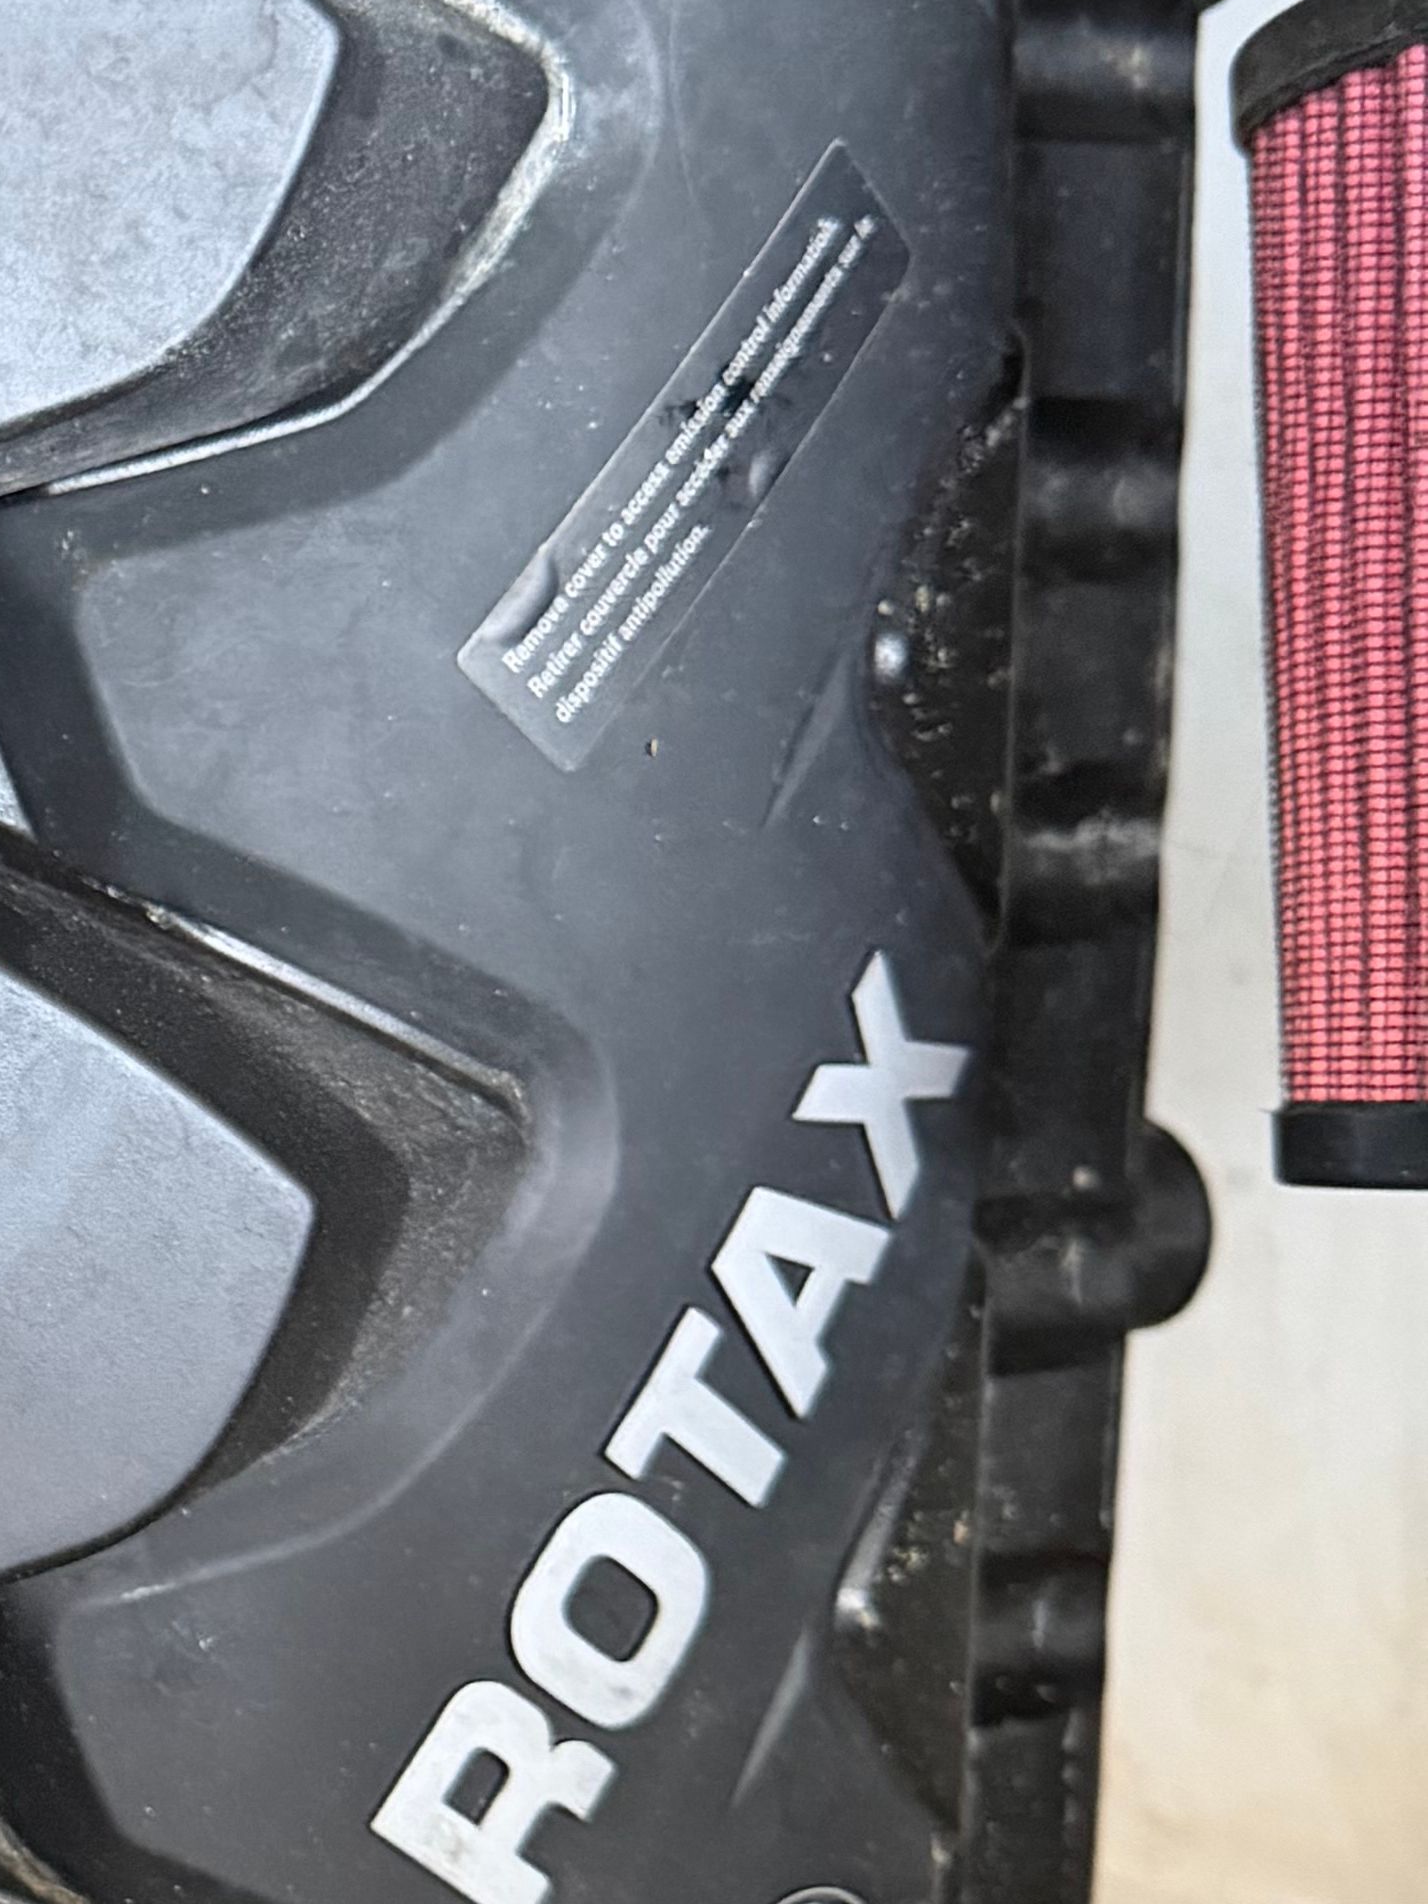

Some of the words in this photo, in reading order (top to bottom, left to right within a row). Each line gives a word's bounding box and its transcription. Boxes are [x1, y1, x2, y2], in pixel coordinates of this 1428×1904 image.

[502, 594, 569, 673] Remove
[563, 546, 606, 599] cover
[600, 522, 625, 547] to
[619, 461, 671, 526] access
[664, 382, 725, 464] emission
[719, 317, 770, 386] control
[527, 634, 584, 698] Retirer
[577, 546, 649, 636] couvercle
[644, 504, 681, 553] pour
[724, 401, 753, 438] aux
[748, 265, 842, 407] renseignements
[837, 236, 861, 268] sur
[553, 634, 623, 724] dispositif
[617, 521, 710, 642] antipollution.
